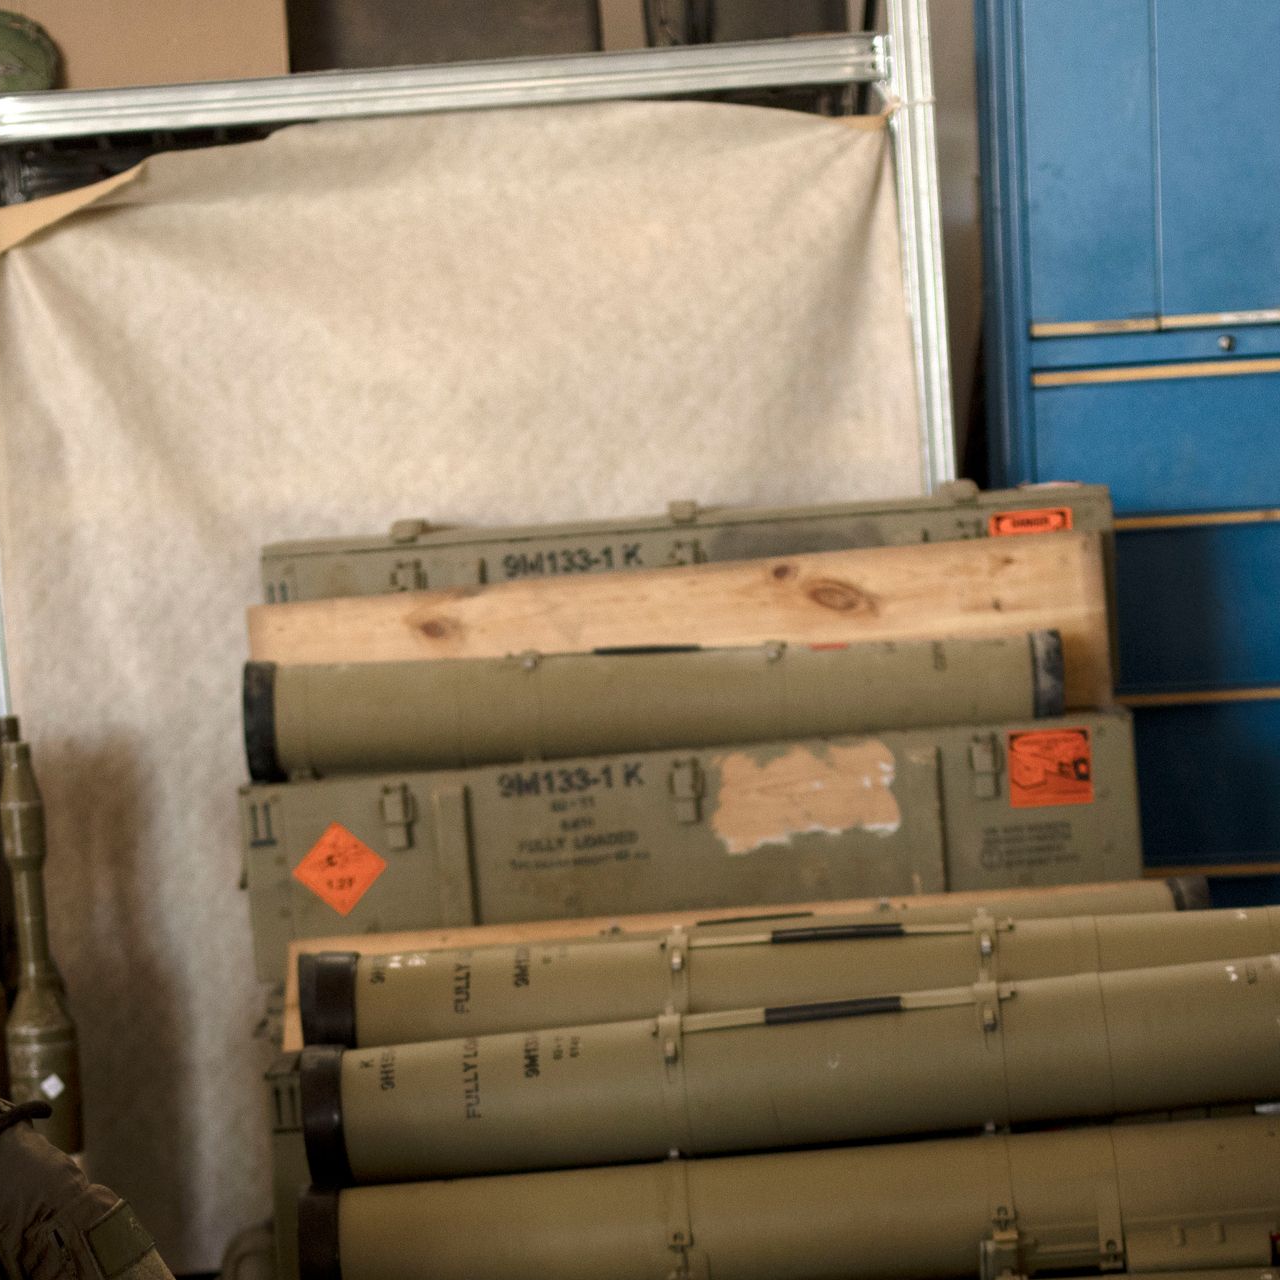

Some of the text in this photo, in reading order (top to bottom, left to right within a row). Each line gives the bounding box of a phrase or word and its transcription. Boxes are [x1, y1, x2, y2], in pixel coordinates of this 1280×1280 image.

[502, 543, 643, 580] 9M133-1 K
[498, 762, 645, 798] 9M133-1 K
[518, 837, 566, 853] FULLY
[462, 1062, 480, 1120] FULLY
